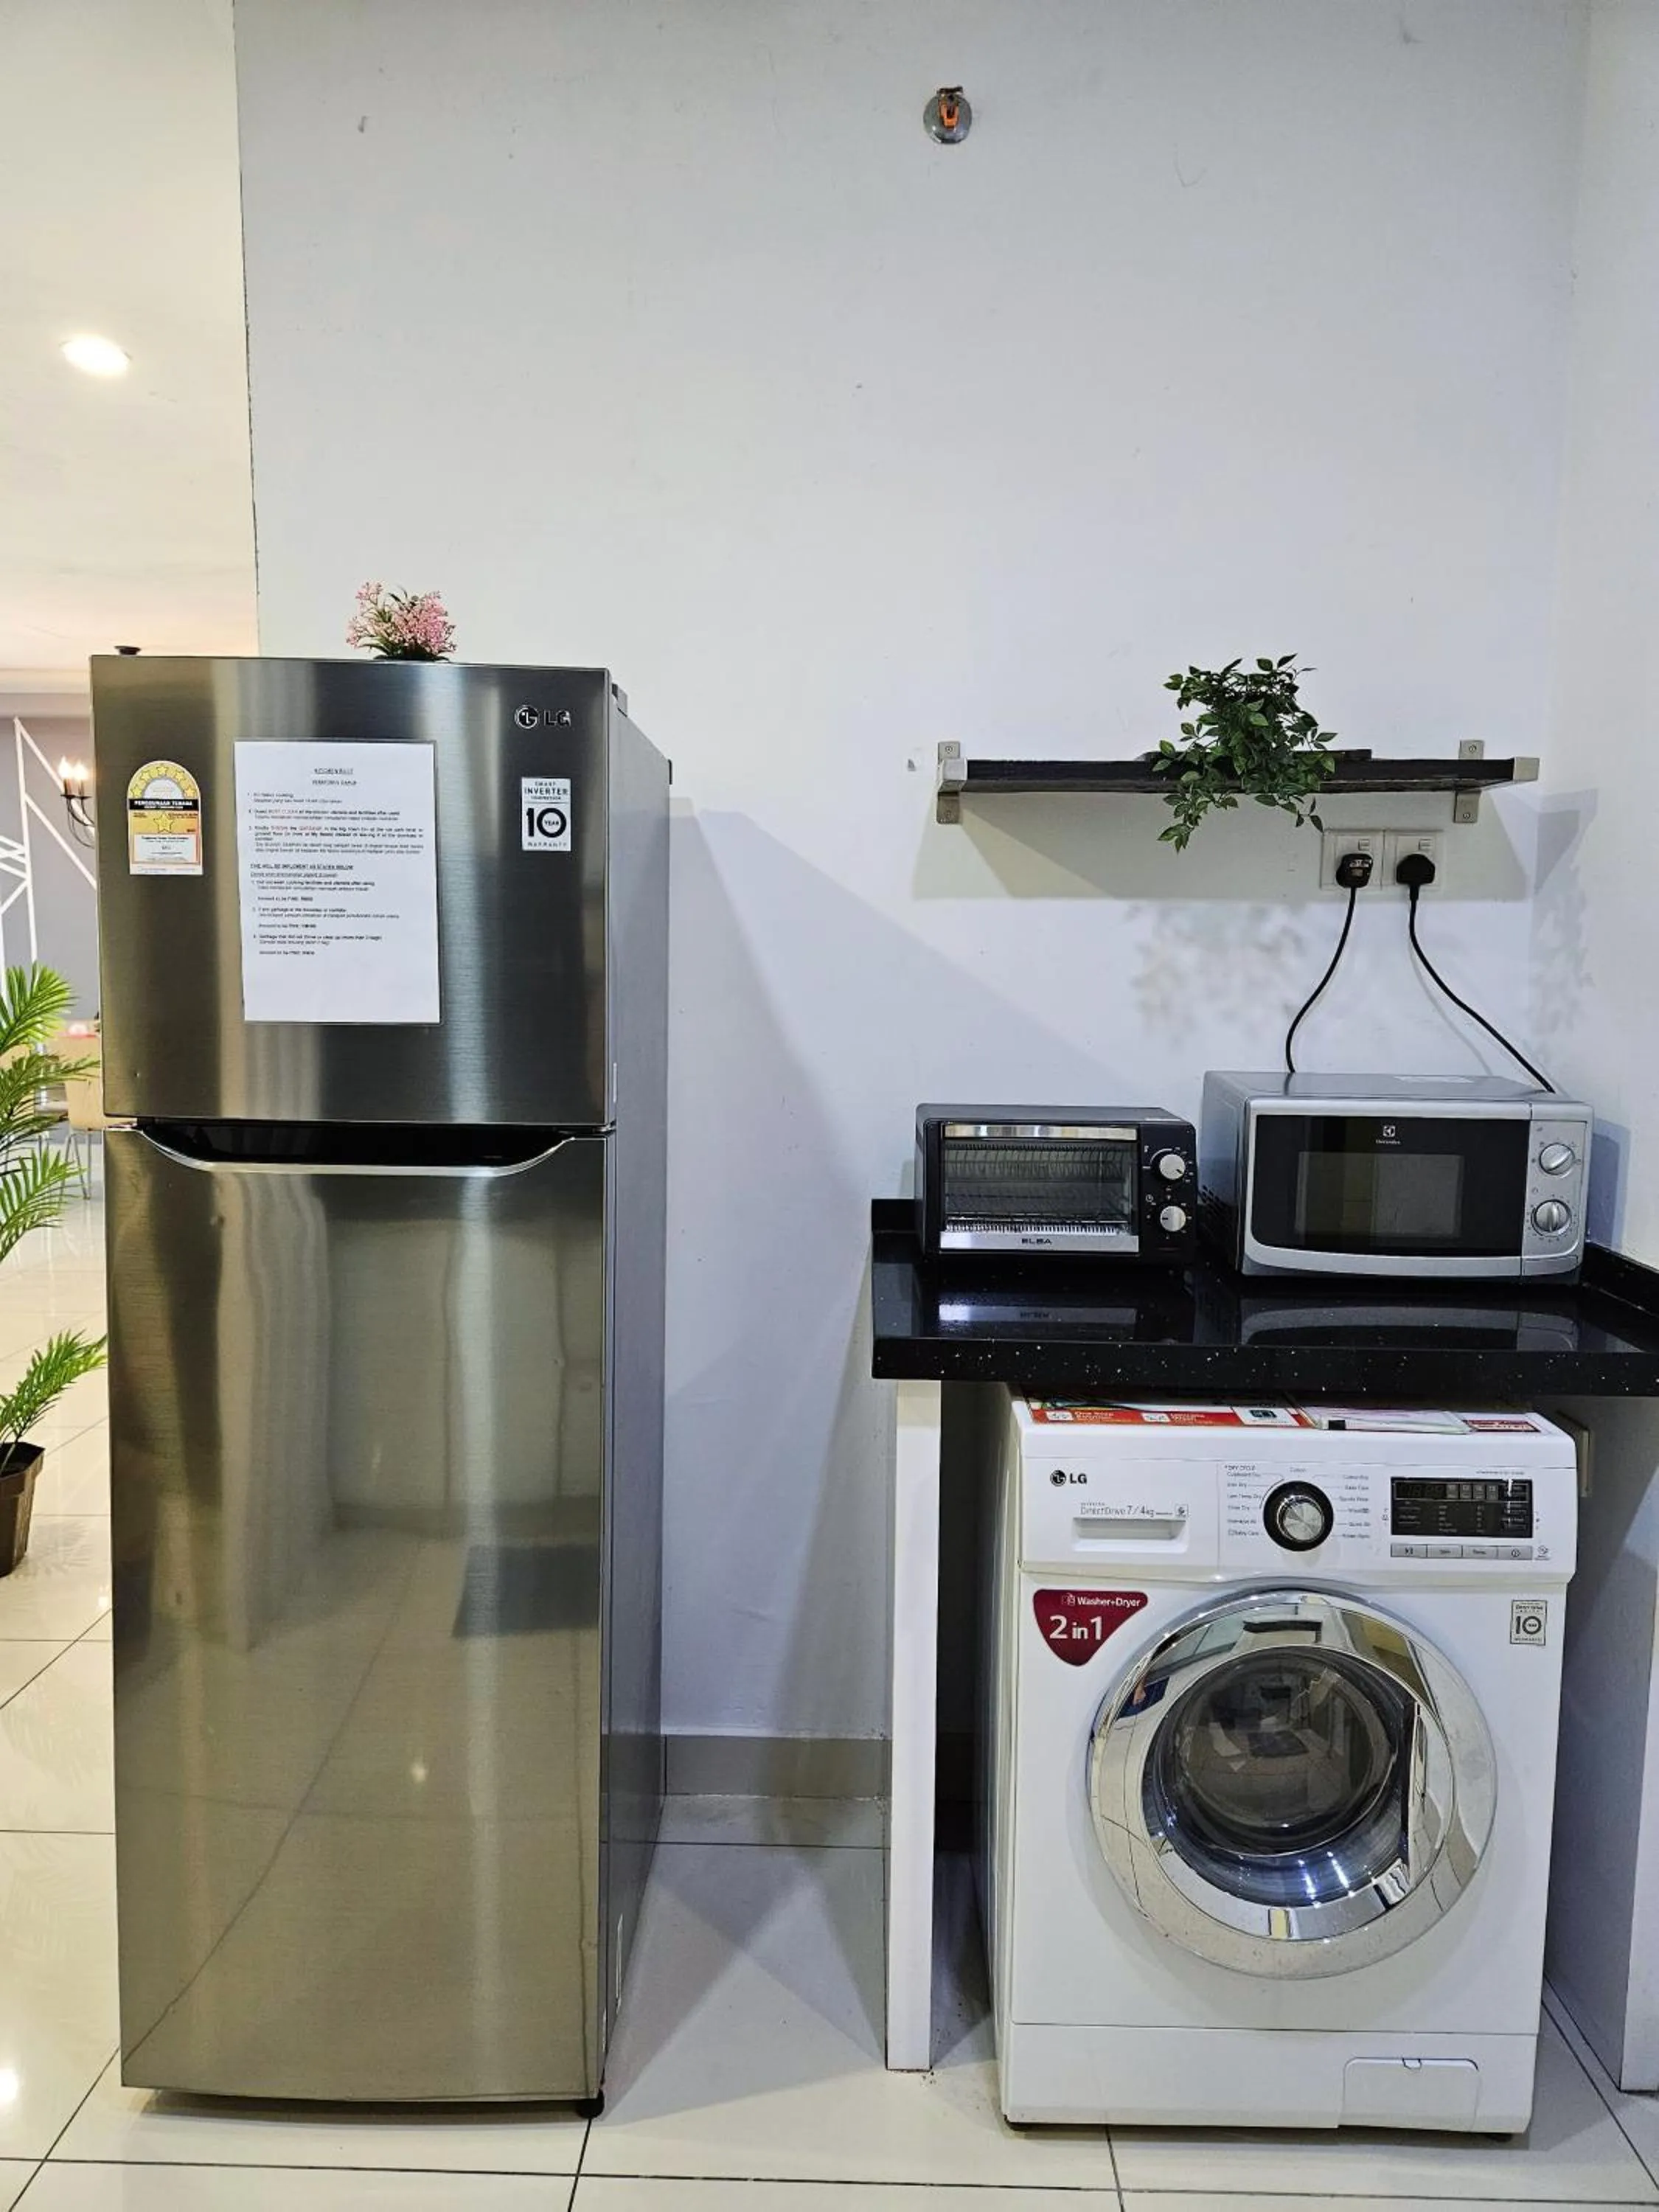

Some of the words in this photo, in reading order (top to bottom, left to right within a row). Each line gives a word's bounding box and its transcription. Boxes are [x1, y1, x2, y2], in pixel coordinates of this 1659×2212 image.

[524, 787, 568, 795] INVERTER
[526, 807, 567, 838] 10
[1069, 1473, 1088, 1485] LG
[1077, 1596, 1140, 1607] Washer+Dryer
[1049, 1615, 1068, 1639] 2
[1071, 1623, 1088, 1639] in
[1091, 1615, 1103, 1640] 1
[1516, 1615, 1542, 1635] 10
